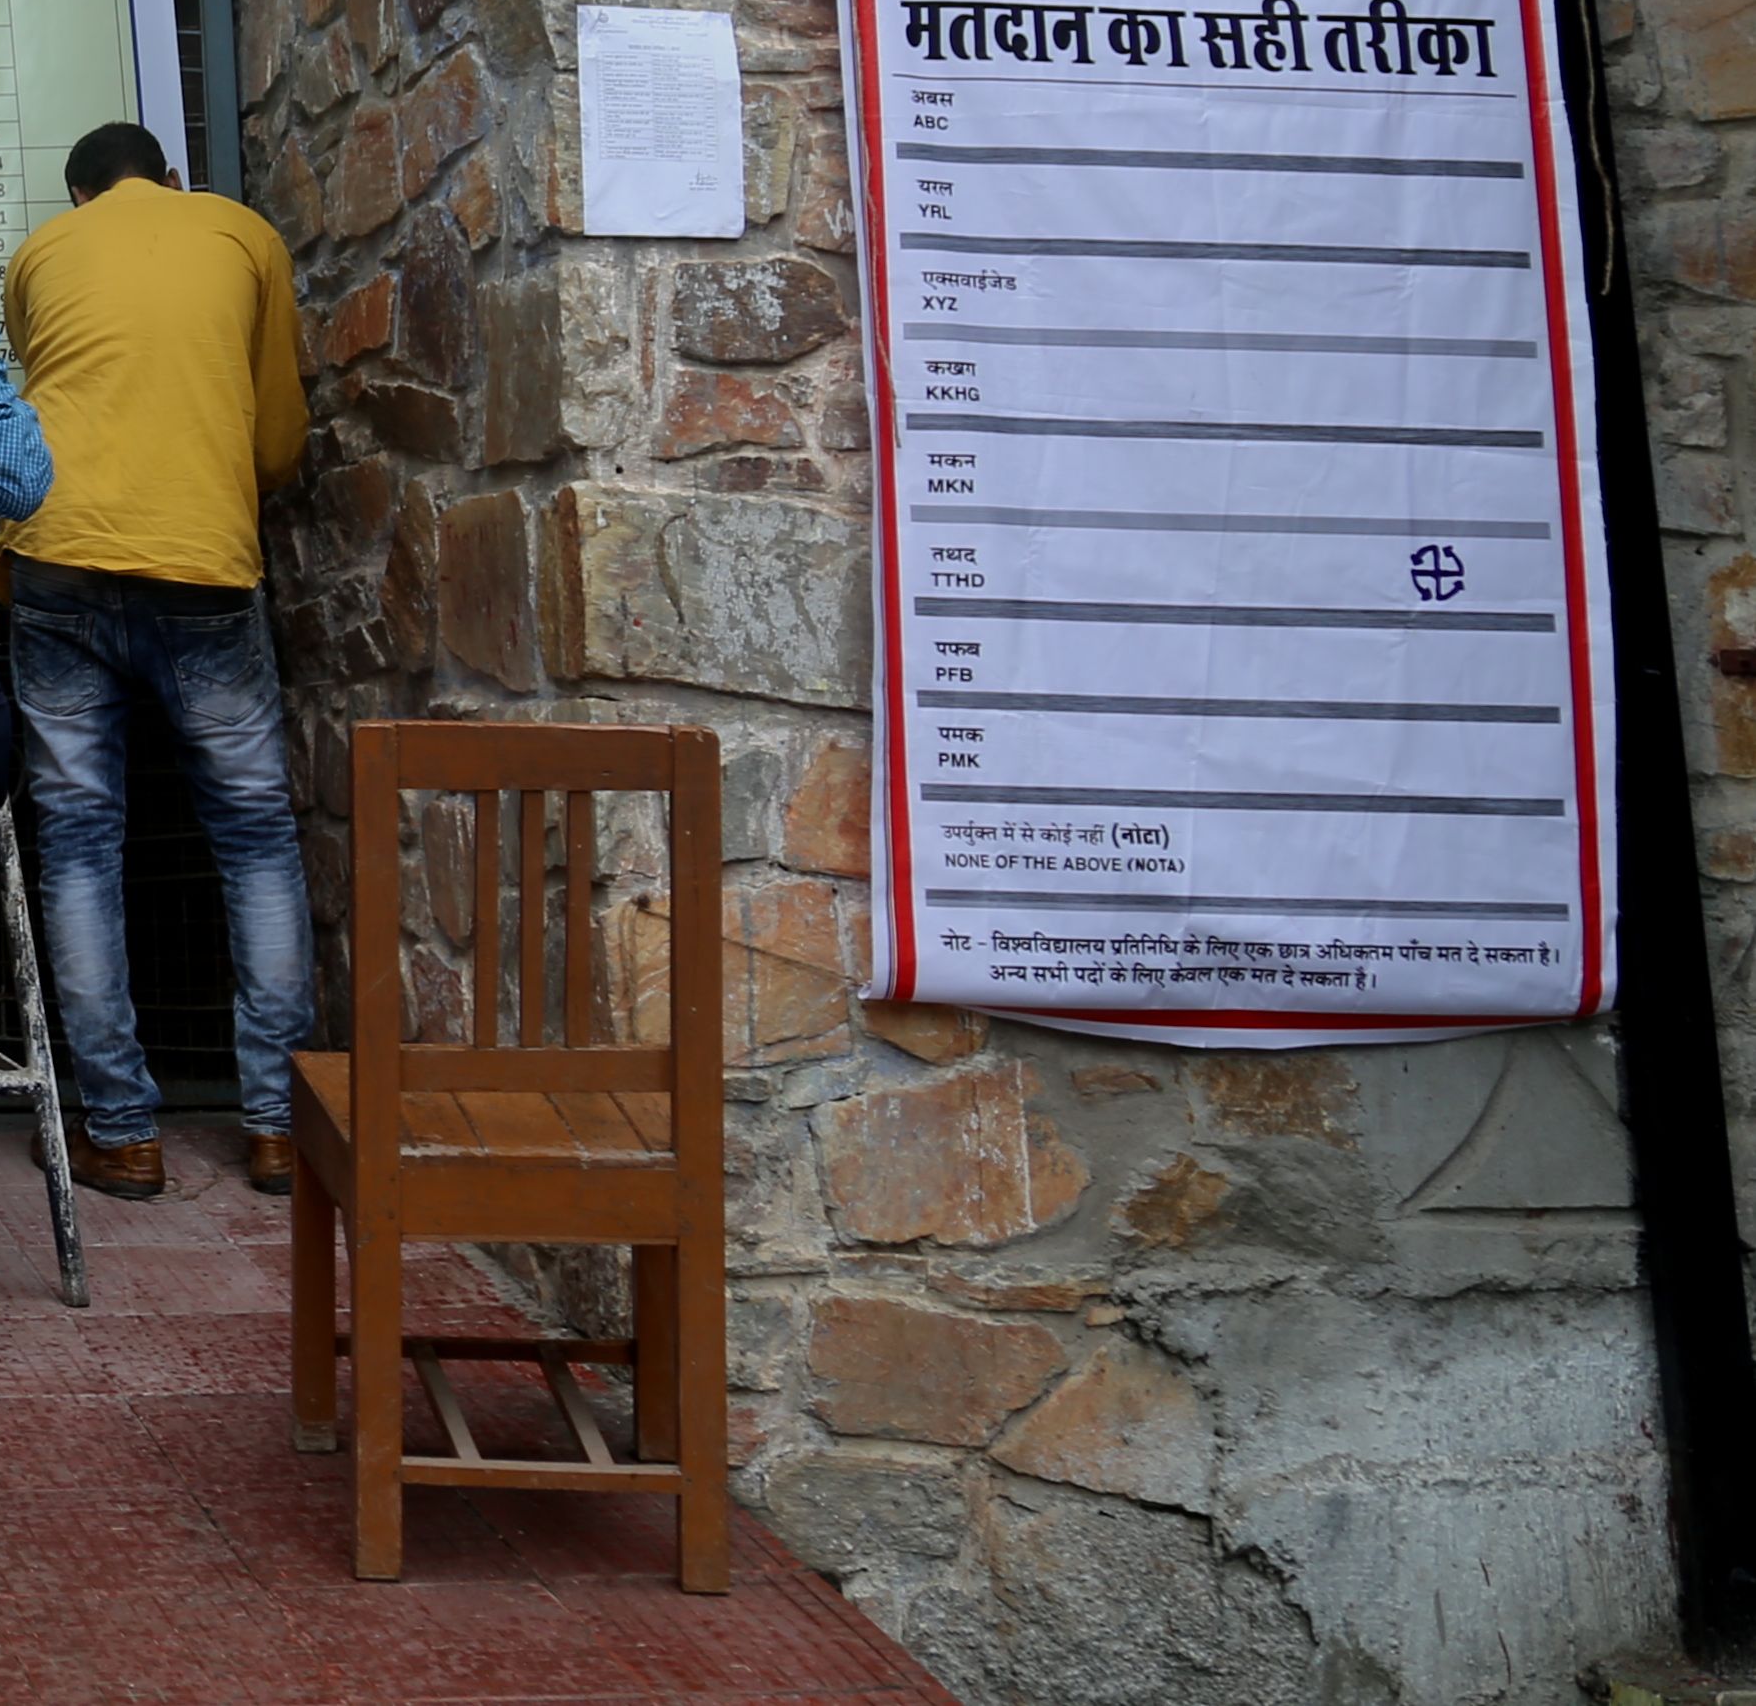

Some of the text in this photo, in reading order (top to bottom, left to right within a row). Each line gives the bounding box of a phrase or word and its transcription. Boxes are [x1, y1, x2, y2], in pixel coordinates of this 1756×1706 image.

[900, 1, 1096, 64] मतदान
[1098, 7, 1190, 68] का
[911, 90, 955, 107] अबस
[913, 114, 949, 131] ABC
[916, 179, 954, 197] यरल
[917, 203, 953, 220] YRL
[921, 269, 1018, 291] एक्सवाईजेड
[922, 295, 959, 312] XYZ
[924, 360, 977, 377] कखग
[925, 385, 981, 402] KKHG
[926, 453, 977, 469] मकन
[927, 478, 975, 494] MKN
[929, 546, 977, 565] तथद
[930, 571, 986, 588] TTHD
[933, 641, 982, 657] पफब
[935, 666, 974, 683] PFB
[937, 726, 986, 743] पमक
[938, 751, 981, 769] PMK
[1002, 820, 1016, 842] में
[1019, 823, 1035, 843] से
[1039, 823, 1073, 845] कोई
[1076, 823, 1107, 845] नहीं
[1111, 822, 1170, 851] (नोटा)
[944, 853, 1186, 874] NONE OF THE ABOVE (NOTA)
[940, 928, 972, 951] नोट
[991, 930, 1106, 955] विश्वविद्यालय
[1110, 933, 1179, 957] प्रतिनिधि
[1182, 932, 1203, 956] के
[1206, 935, 1240, 962] लिए
[1242, 941, 1274, 963] एक
[1277, 942, 1311, 961] छात्र
[1316, 939, 1394, 963] अधिकतम
[1398, 939, 1432, 963] पाँच
[1437, 945, 1463, 964] मत
[1468, 940, 1481, 966] दे
[1484, 946, 1535, 965] सकता
[990, 962, 1027, 983] अन्य
[1033, 961, 1069, 984] सभी
[1073, 961, 1103, 987] पदों
[1109, 963, 1127, 983] के
[1131, 965, 1165, 989] लिए
[1169, 965, 1212, 985] केवल
[1216, 966, 1247, 988] एक
[1251, 967, 1277, 987] मत
[1282, 965, 1294, 989] दे
[1299, 969, 1350, 989] सकता
